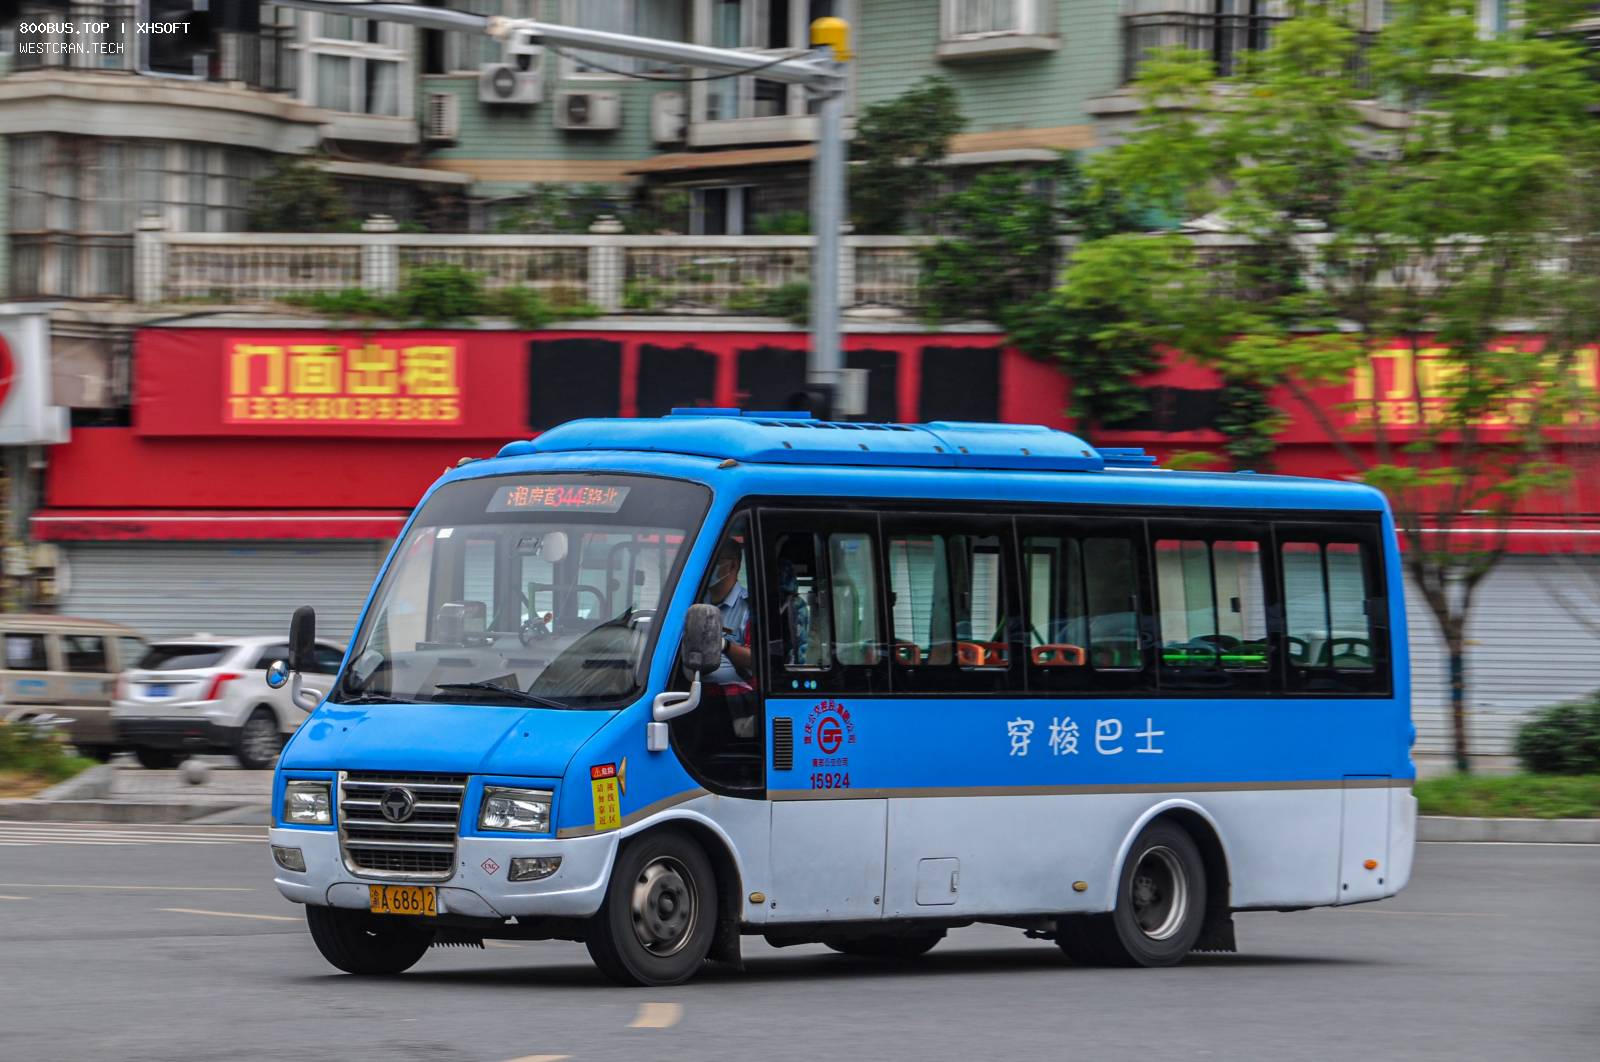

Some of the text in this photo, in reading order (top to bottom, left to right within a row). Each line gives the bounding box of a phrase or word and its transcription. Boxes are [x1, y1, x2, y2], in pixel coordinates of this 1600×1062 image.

[230, 344, 459, 395] 门面出租
[1007, 716, 1165, 756] 穿梭巴士
[811, 773, 850, 789] 15924
